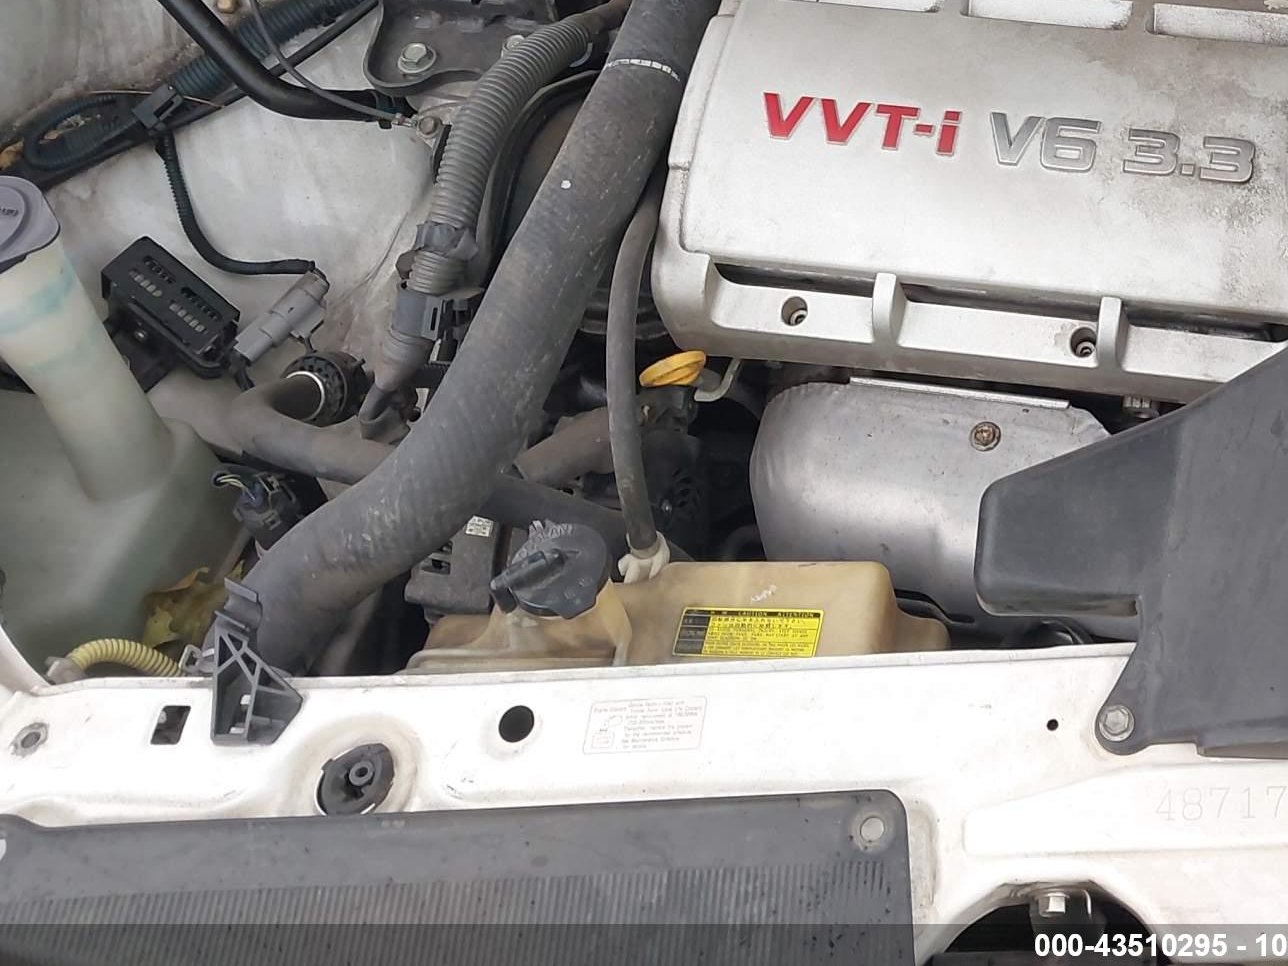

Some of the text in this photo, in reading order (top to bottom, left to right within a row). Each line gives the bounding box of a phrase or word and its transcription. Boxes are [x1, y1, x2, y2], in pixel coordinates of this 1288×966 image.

[763, 91, 1255, 185] VVT-i V6 3.3
[1154, 785, 1288, 822] 48717
